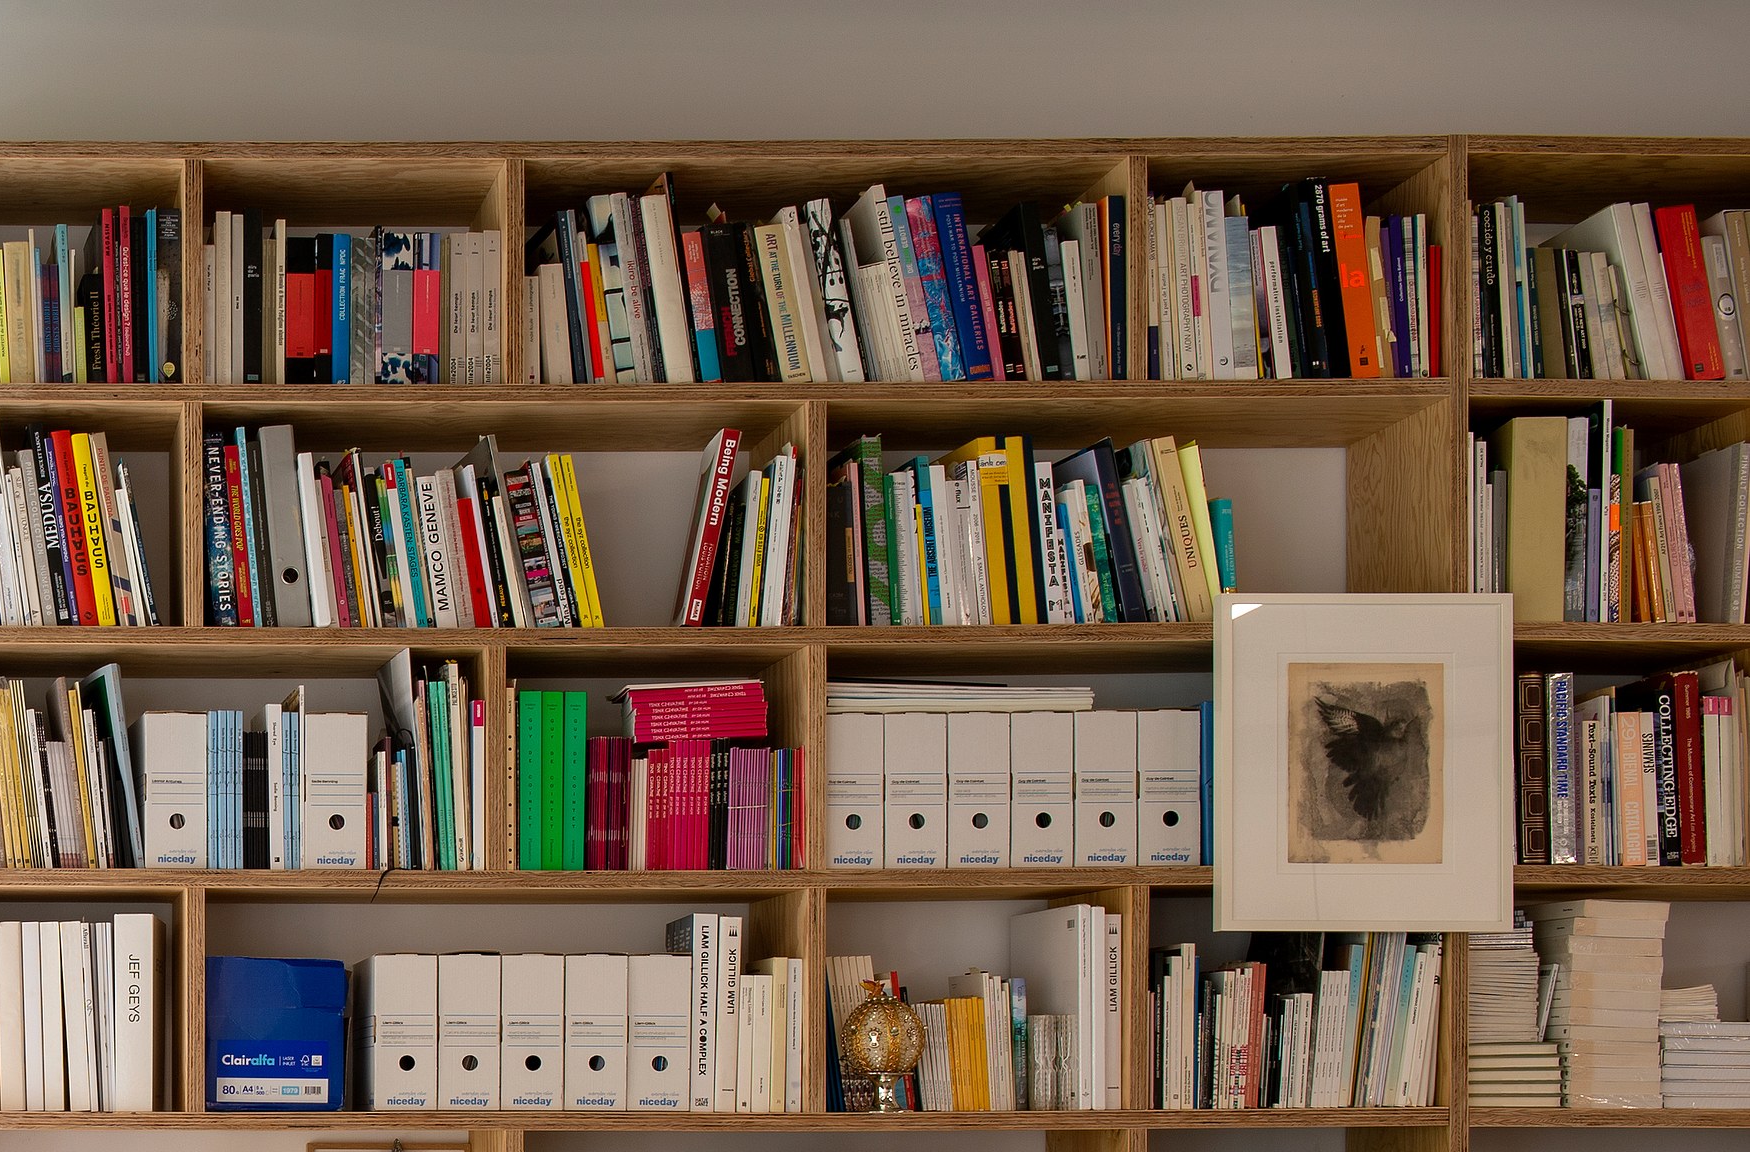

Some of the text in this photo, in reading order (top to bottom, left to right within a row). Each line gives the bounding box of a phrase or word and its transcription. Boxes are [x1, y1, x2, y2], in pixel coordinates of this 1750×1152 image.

[876, 208, 891, 236] still
[1315, 184, 1331, 253] 2870 grams of art
[1484, 210, 1493, 246] cocido
[883, 237, 902, 288] believe
[953, 213, 984, 350] INTERNATIONAL ART GALLERIES
[1486, 255, 1495, 285] crudo
[338, 281, 346, 321] COLLECTION
[726, 268, 746, 346] CONNECTION
[765, 233, 778, 250] ART
[780, 314, 800, 370] MILLENNIUM
[895, 292, 905, 309] in
[92, 343, 102, 371] Fresh
[898, 313, 919, 372] miracles
[708, 438, 737, 527] Being Modern
[40, 482, 60, 550] MEDUSA
[65, 487, 88, 577] BAUHAUS
[83, 490, 104, 569] BAUHAUS
[207, 446, 231, 612] NEVER-ENDING STORIES
[374, 505, 384, 543] Debout!
[397, 471, 408, 509] BARBARA
[408, 546, 419, 578] STAGES
[422, 482, 449, 611] MAMCO GENEVE
[567, 540, 579, 569] collection
[579, 540, 590, 569] collection
[1177, 514, 1198, 569] UNIQUES
[556, 578, 572, 624] Max Feed
[1556, 681, 1569, 799] PACIFIC STANDARD TIME
[1588, 723, 1597, 778] Text-Sound
[1642, 733, 1654, 774] SEMAINES
[157, 854, 196, 865] niceday
[317, 857, 355, 866] niceday
[834, 855, 872, 864] niceday
[897, 855, 936, 864] niceday
[960, 855, 999, 864] niceday
[1087, 853, 1126, 862] niceday
[128, 954, 141, 1023] JEF GEYS
[698, 925, 710, 1076] LIAM GILLICK HALF A COMPLEX
[726, 948, 737, 1015] LIAM GILLICK
[1109, 946, 1118, 1012] LIAM GILLICK
[221, 1053, 275, 1067] Clairalfa
[242, 1085, 253, 1094] A4
[387, 1097, 426, 1106] niceday
[513, 1097, 552, 1106] niceday
[639, 1097, 678, 1106] niceday
